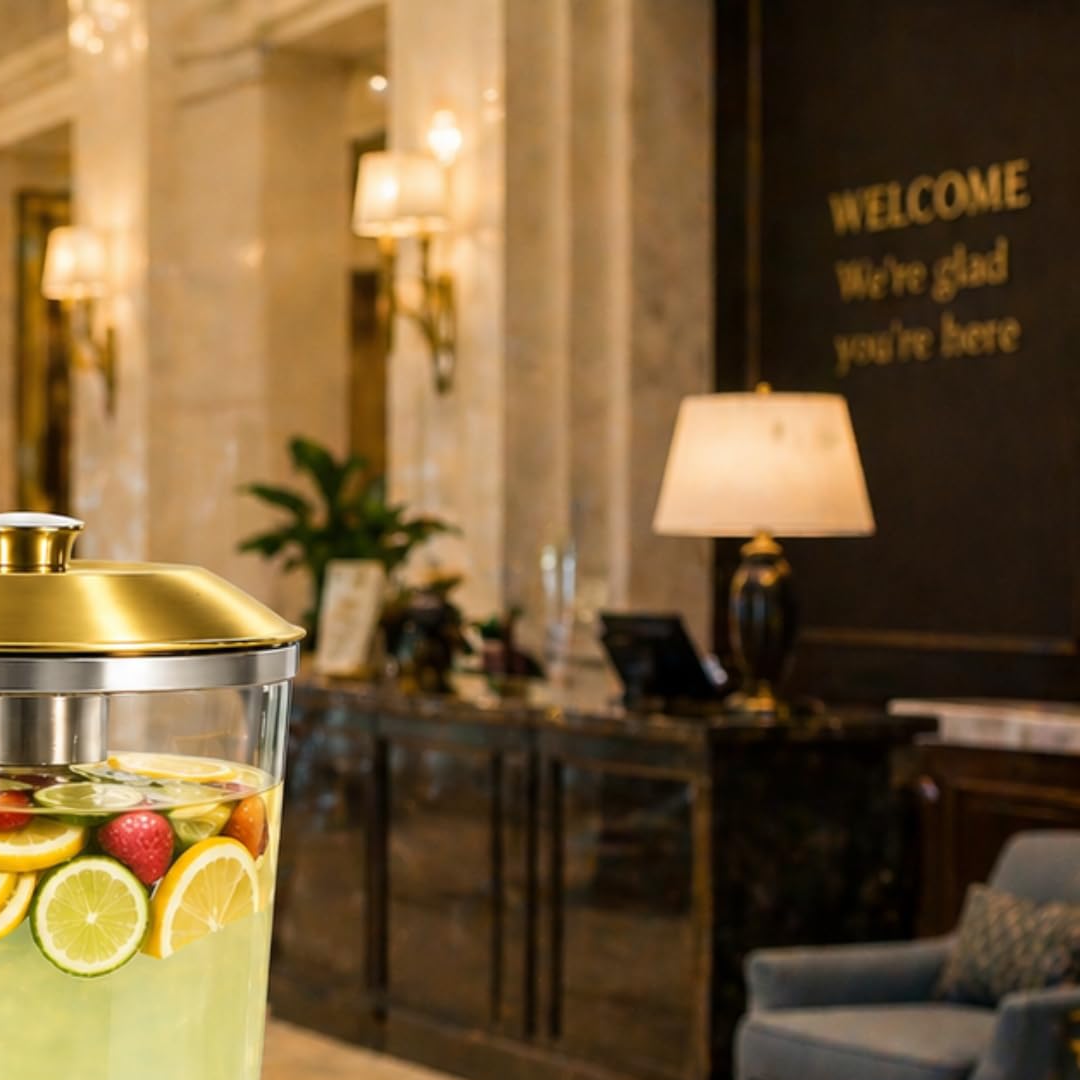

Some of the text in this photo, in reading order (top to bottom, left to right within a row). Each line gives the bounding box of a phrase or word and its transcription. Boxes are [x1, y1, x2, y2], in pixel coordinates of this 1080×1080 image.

[827, 157, 1032, 236] WELCOME
[834, 235, 1009, 303] We're glad
[832, 310, 1021, 378] you're here
